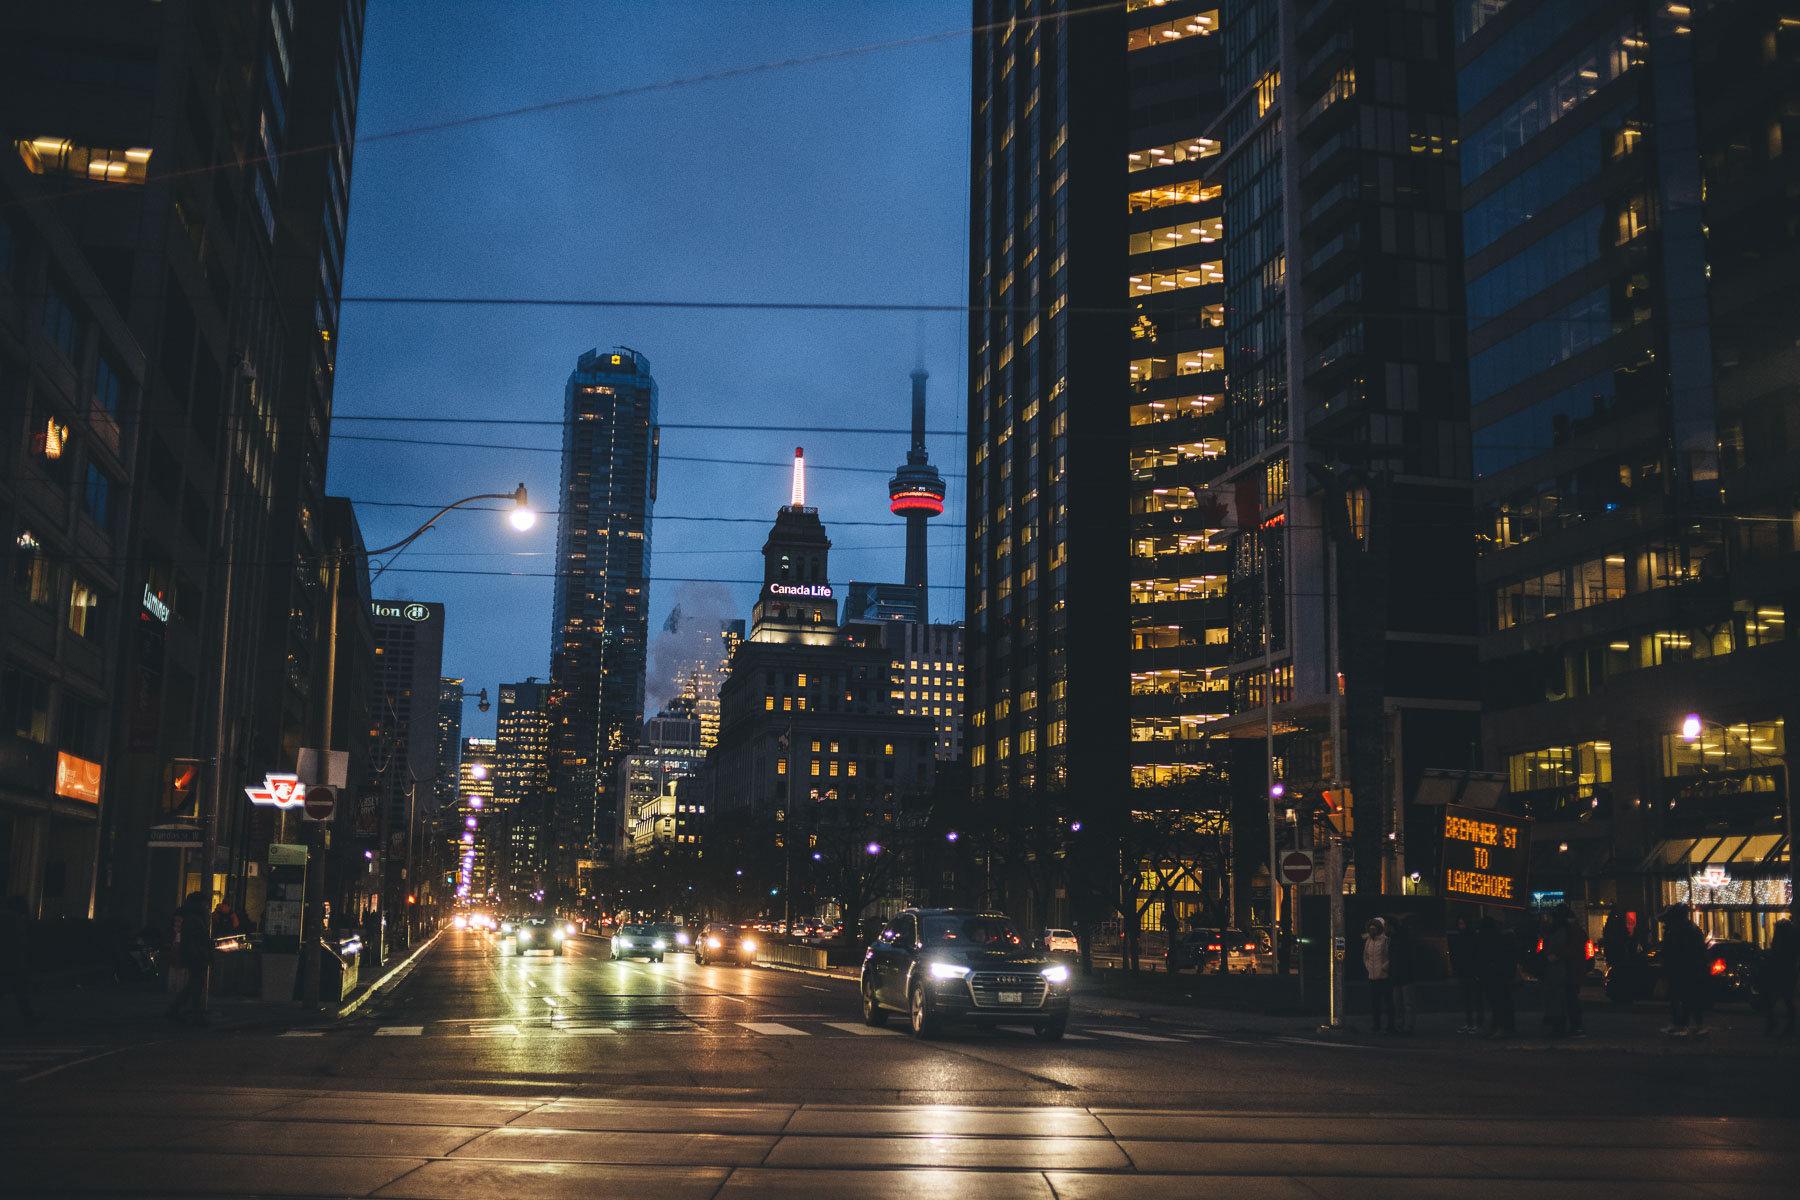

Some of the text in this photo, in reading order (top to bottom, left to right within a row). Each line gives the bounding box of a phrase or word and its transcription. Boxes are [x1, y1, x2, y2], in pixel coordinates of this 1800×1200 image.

[143, 583, 170, 622] Luminex
[770, 583, 832, 597] Canada Life
[1445, 816, 1518, 849] BREMNER ST
[1474, 847, 1488, 869] TO
[1447, 869, 1514, 898] LAKESHORE
